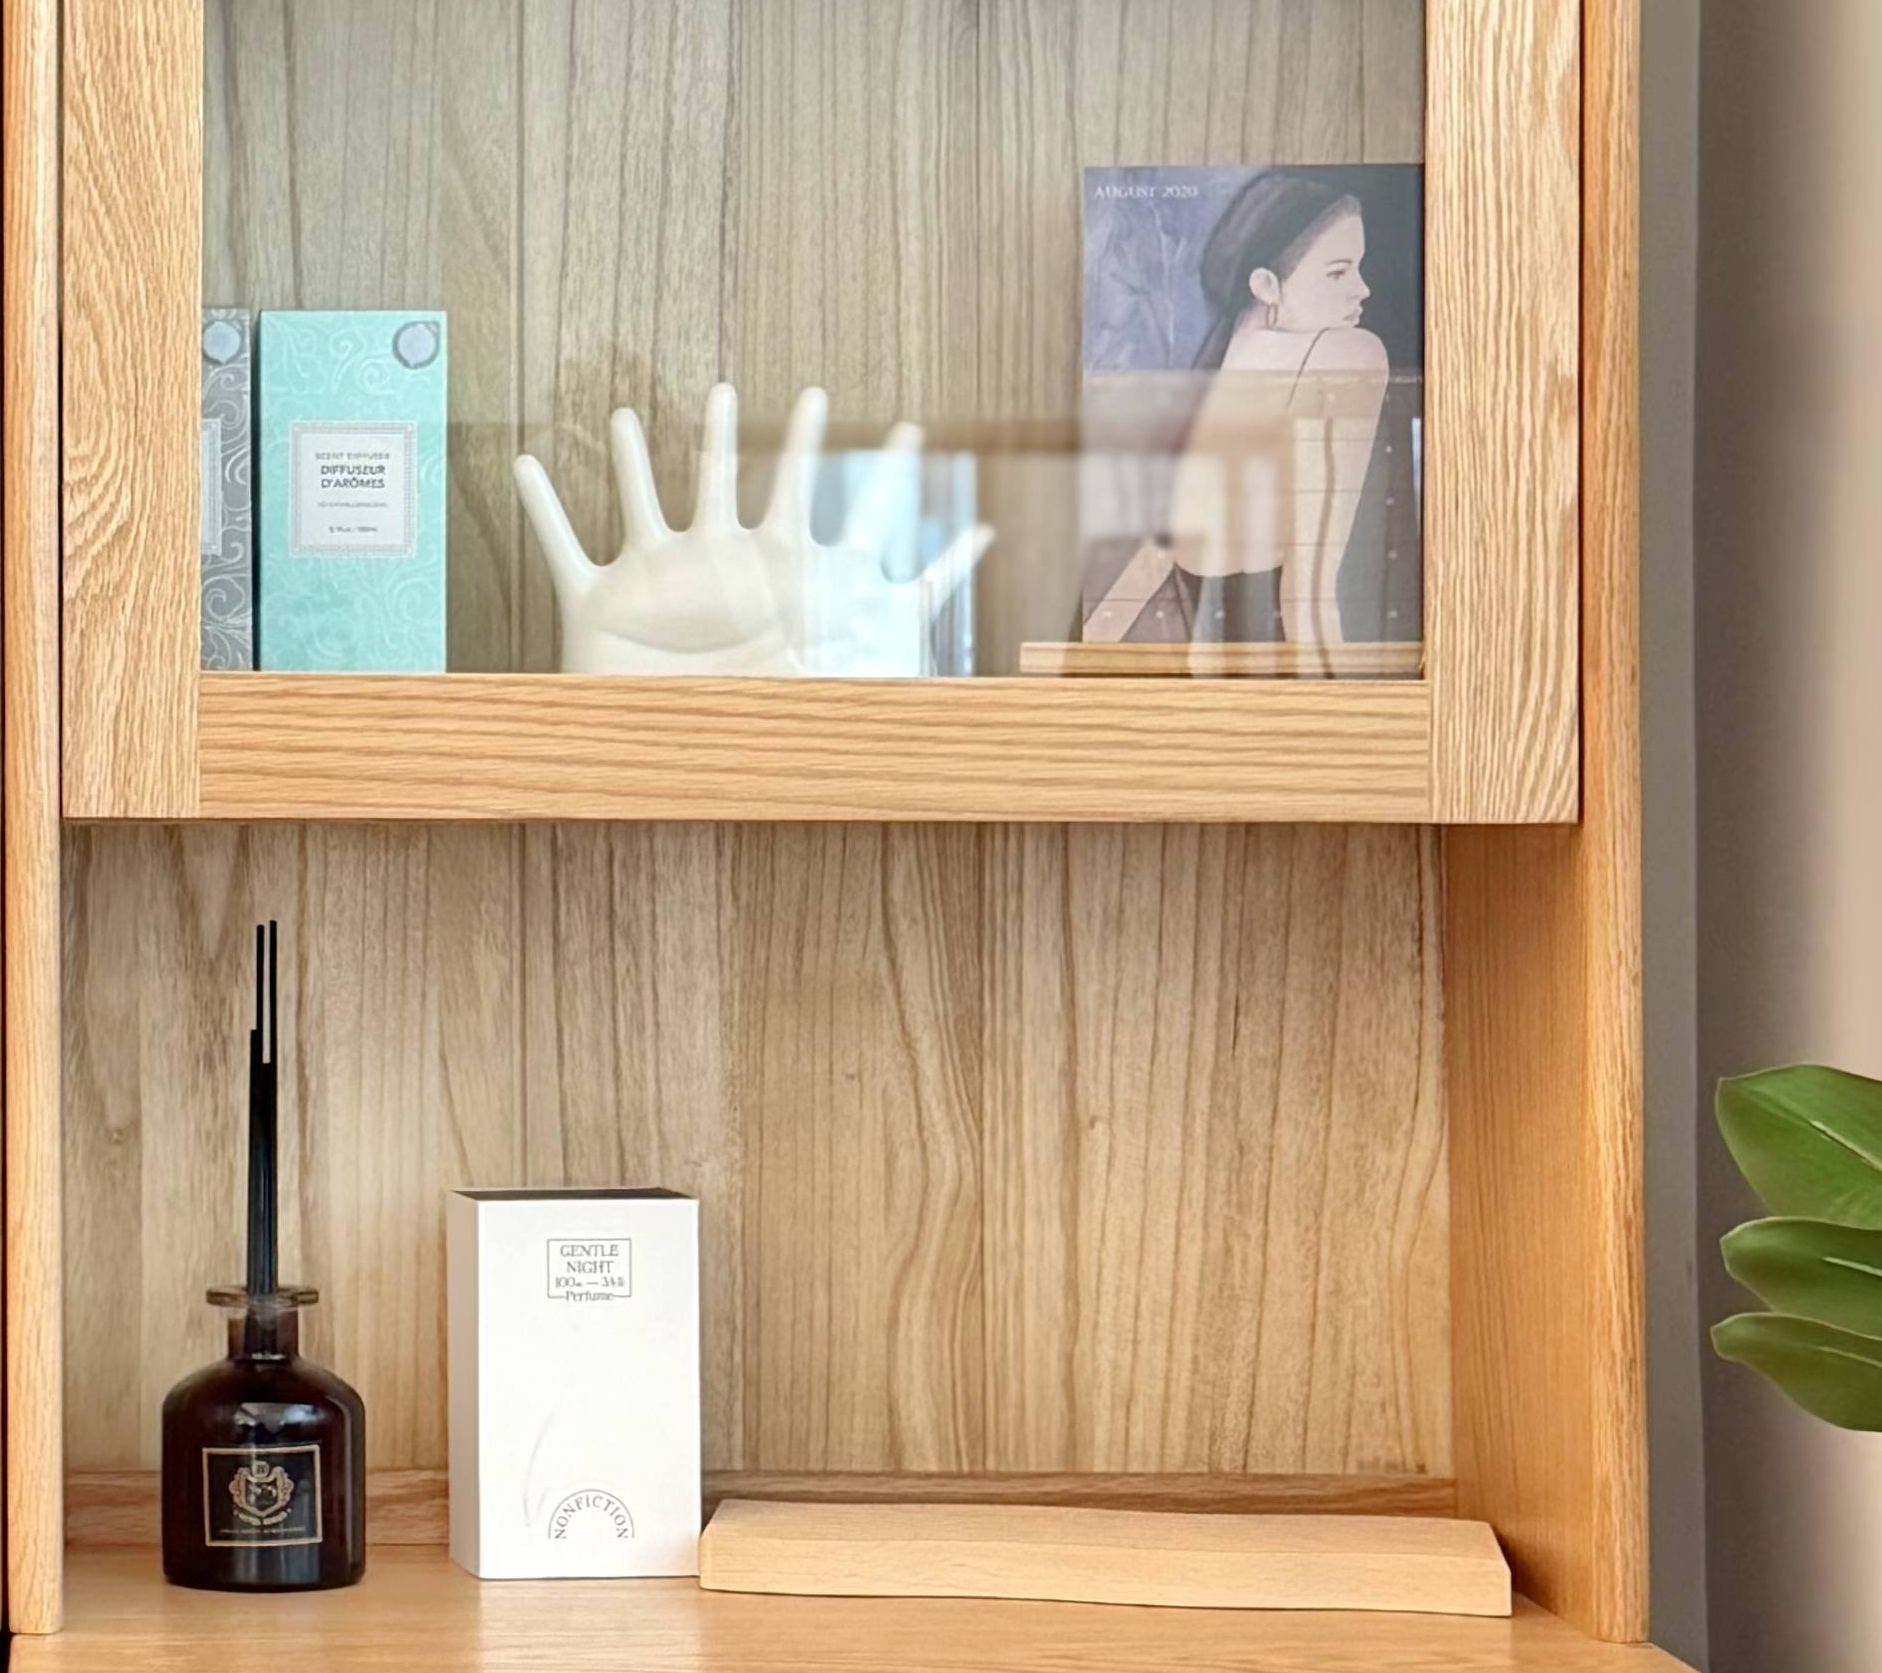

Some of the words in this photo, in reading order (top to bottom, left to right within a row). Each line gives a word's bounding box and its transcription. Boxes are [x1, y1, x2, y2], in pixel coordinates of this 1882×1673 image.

[321, 465, 386, 475] DIFFUSEUR
[560, 1244, 619, 1257] GENTLE
[566, 1260, 615, 1274] NIGHT
[554, 1494, 629, 1540] NONFICTION
